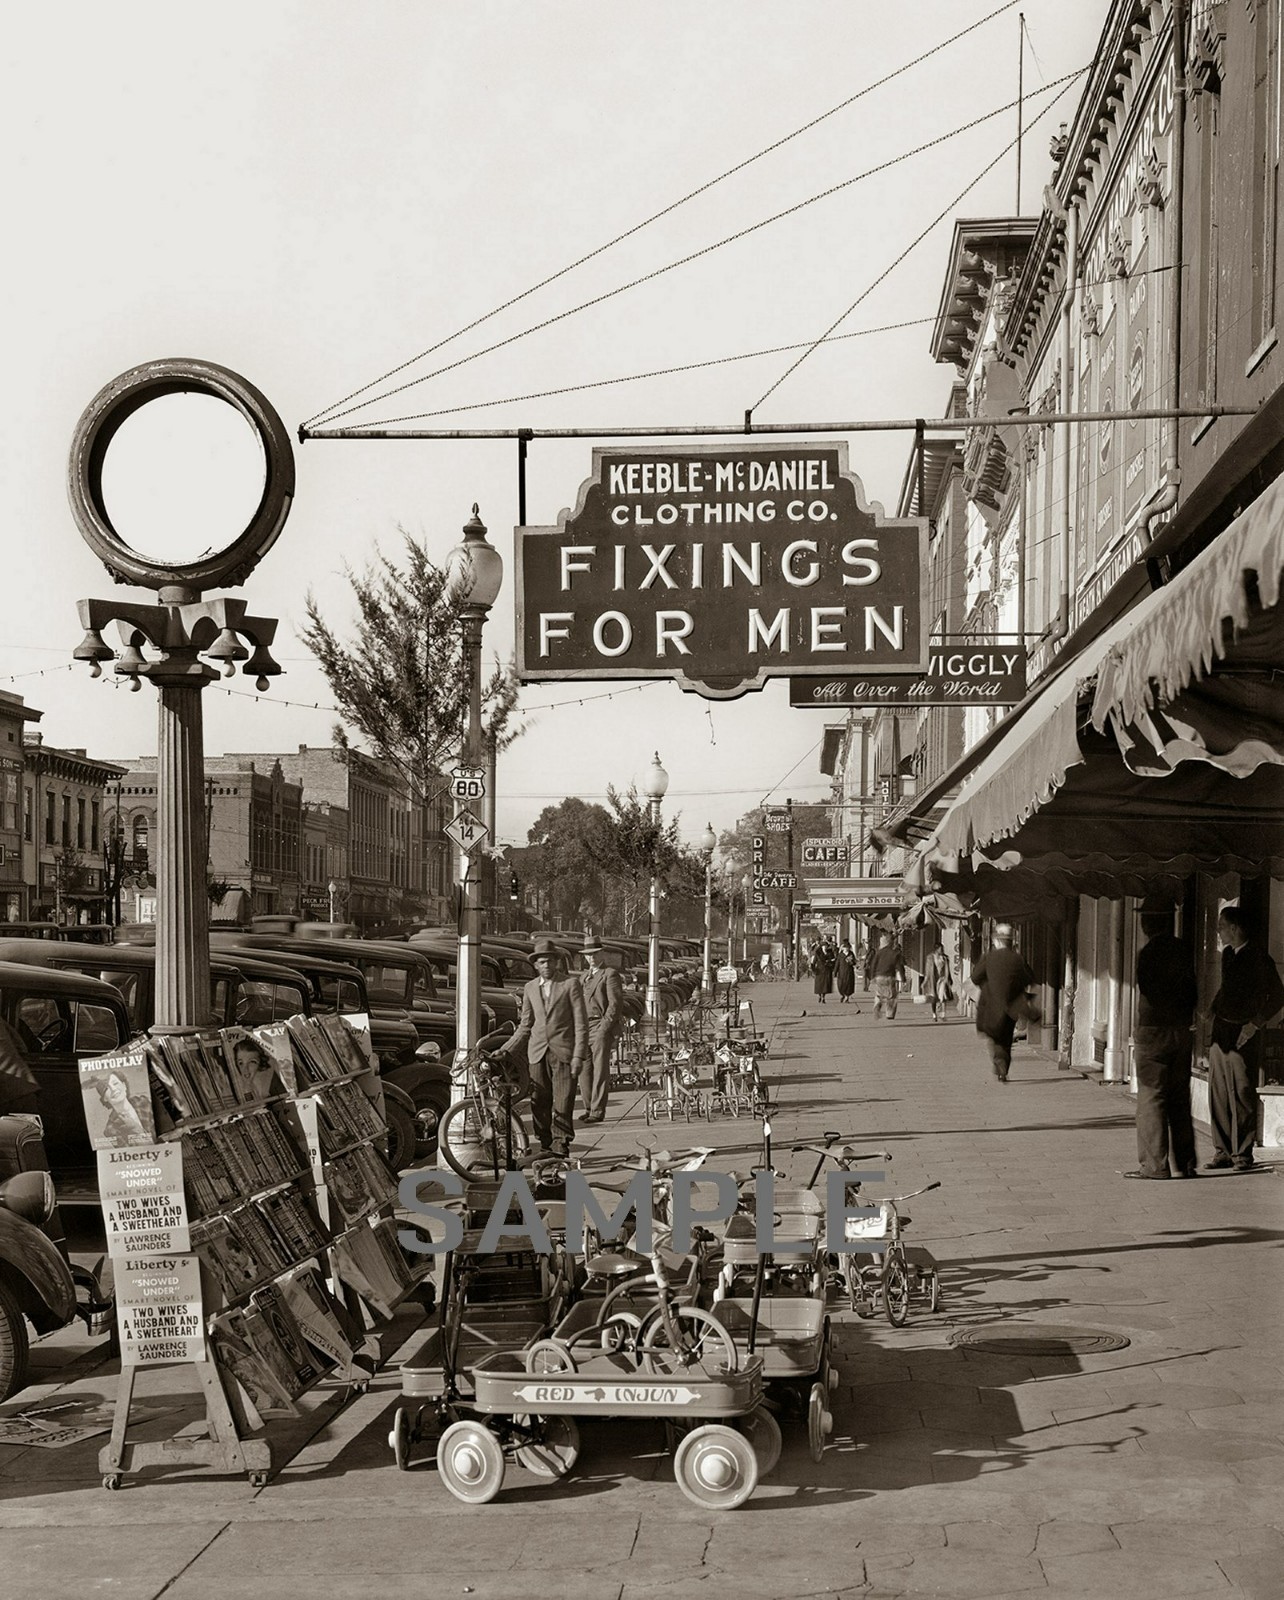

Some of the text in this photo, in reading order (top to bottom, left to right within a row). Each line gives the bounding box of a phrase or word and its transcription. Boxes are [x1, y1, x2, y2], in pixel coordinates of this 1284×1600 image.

[611, 500, 838, 525] CLOTHING CO.
[560, 538, 882, 591] FIXINGS
[539, 610, 695, 657] FOR
[748, 605, 904, 654] MEN
[812, 680, 1003, 698] All Over the World
[457, 780, 478, 796] 80
[460, 826, 475, 840] 14
[805, 847, 847, 861] CAFE
[761, 877, 796, 888] CAFE
[867, 896, 893, 904] Shoe
[80, 1055, 143, 1073] PHOTOPLAY
[110, 1150, 160, 1163] Liberty
[116, 1196, 170, 1210] TWO WIVES
[109, 1206, 181, 1222] A HUSBAND AND
[113, 1216, 181, 1232] A SWEETHEART
[124, 1233, 171, 1244] LAWRENCE
[126, 1241, 171, 1252] SAUNDERS
[126, 1260, 177, 1271] Liberty
[132, 1305, 188, 1317] TWO WIVES
[124, 1316, 198, 1329] A HUSBAND AND
[127, 1326, 197, 1339] A SWEETHEART
[138, 1342, 187, 1352] LAWRENCE
[140, 1350, 187, 1360] SAUNDERS
[535, 1387, 678, 1402] RED INJUN
